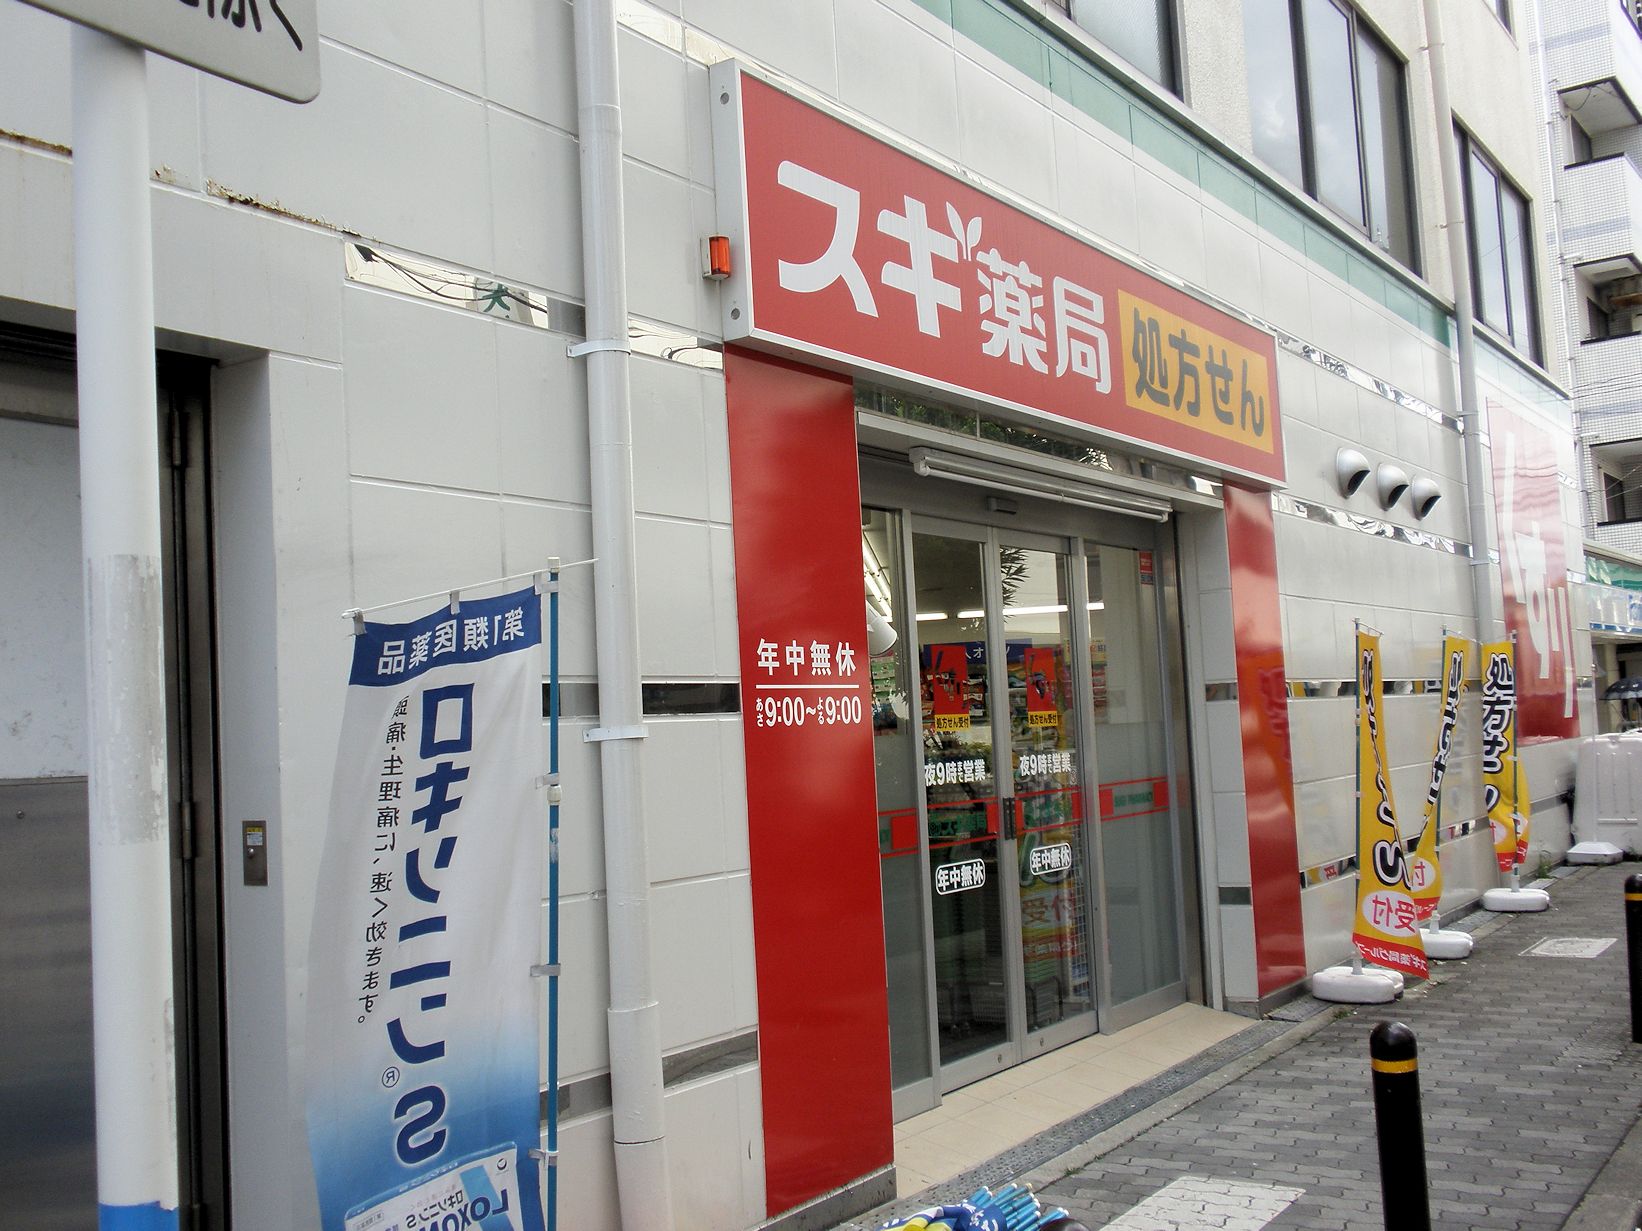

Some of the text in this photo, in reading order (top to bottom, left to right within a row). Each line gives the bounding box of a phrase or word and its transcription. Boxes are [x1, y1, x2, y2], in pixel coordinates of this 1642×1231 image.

[777, 160, 1112, 395] スギ薬局
[1131, 307, 1265, 438] 処方せん
[756, 638, 857, 677] 年中無休
[936, 862, 985, 891] 年中無休
[1031, 846, 1071, 872] 年中無休
